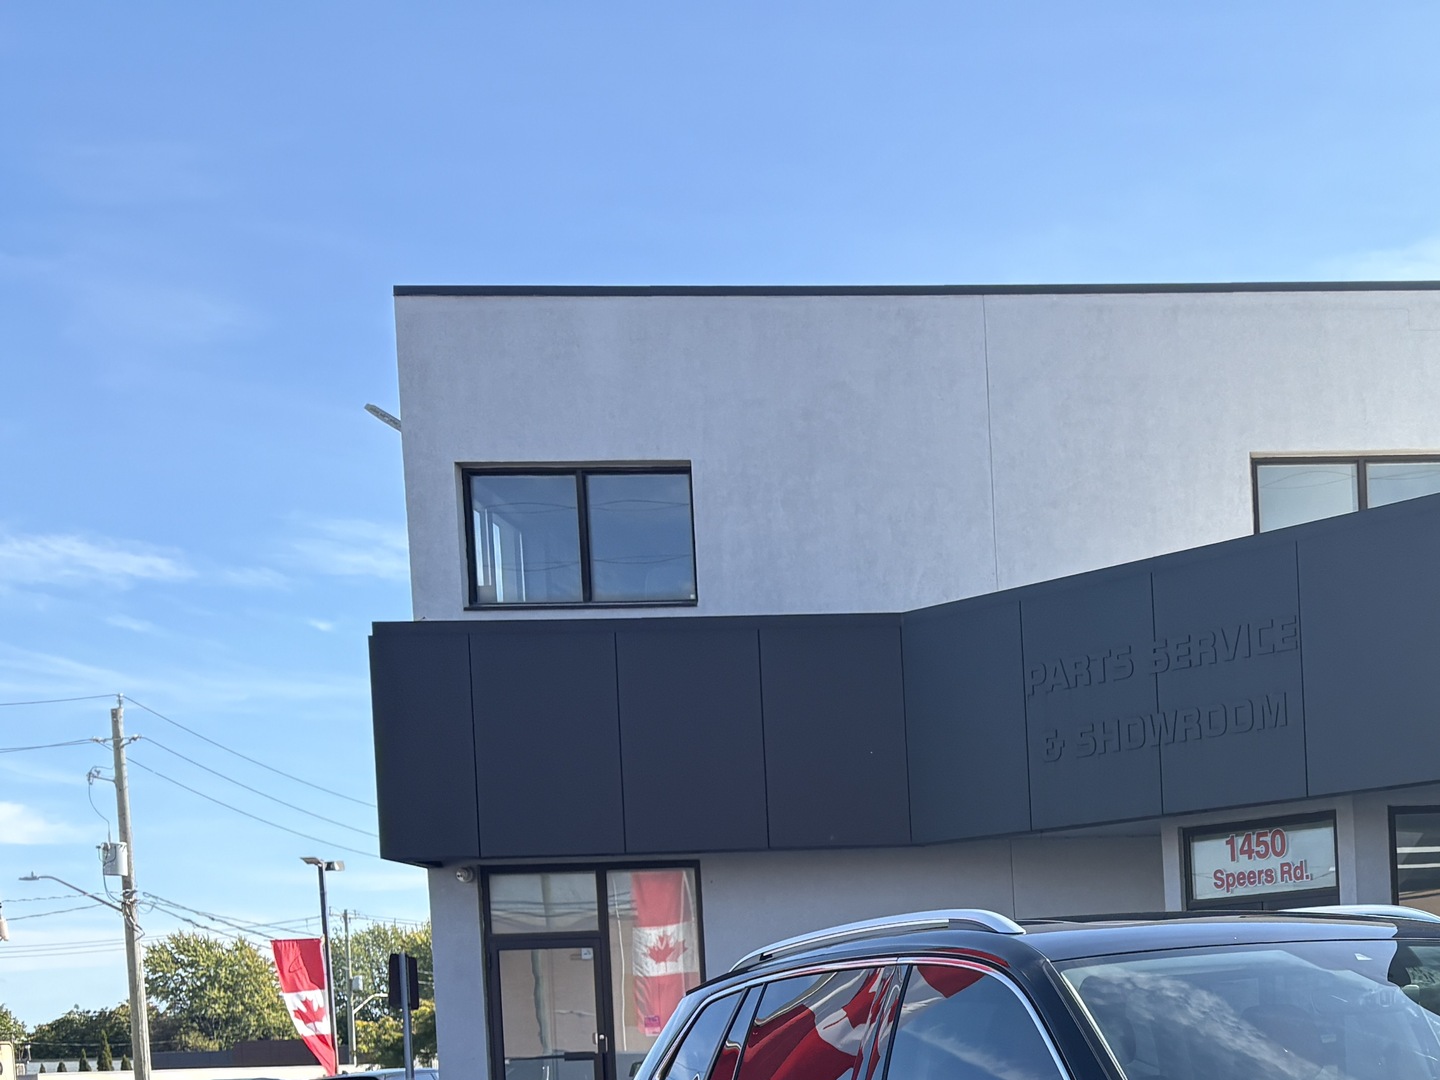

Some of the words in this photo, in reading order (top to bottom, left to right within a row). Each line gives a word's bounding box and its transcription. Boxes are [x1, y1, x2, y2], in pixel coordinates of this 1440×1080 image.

[1026, 644, 1135, 698] PARTS
[1150, 614, 1299, 676] SERVICE
[1043, 728, 1066, 763] &
[1076, 691, 1289, 759] SHOWROOM
[1225, 828, 1288, 862] 1450
[1213, 868, 1275, 894] Speers
[1280, 860, 1311, 882] Rd.
